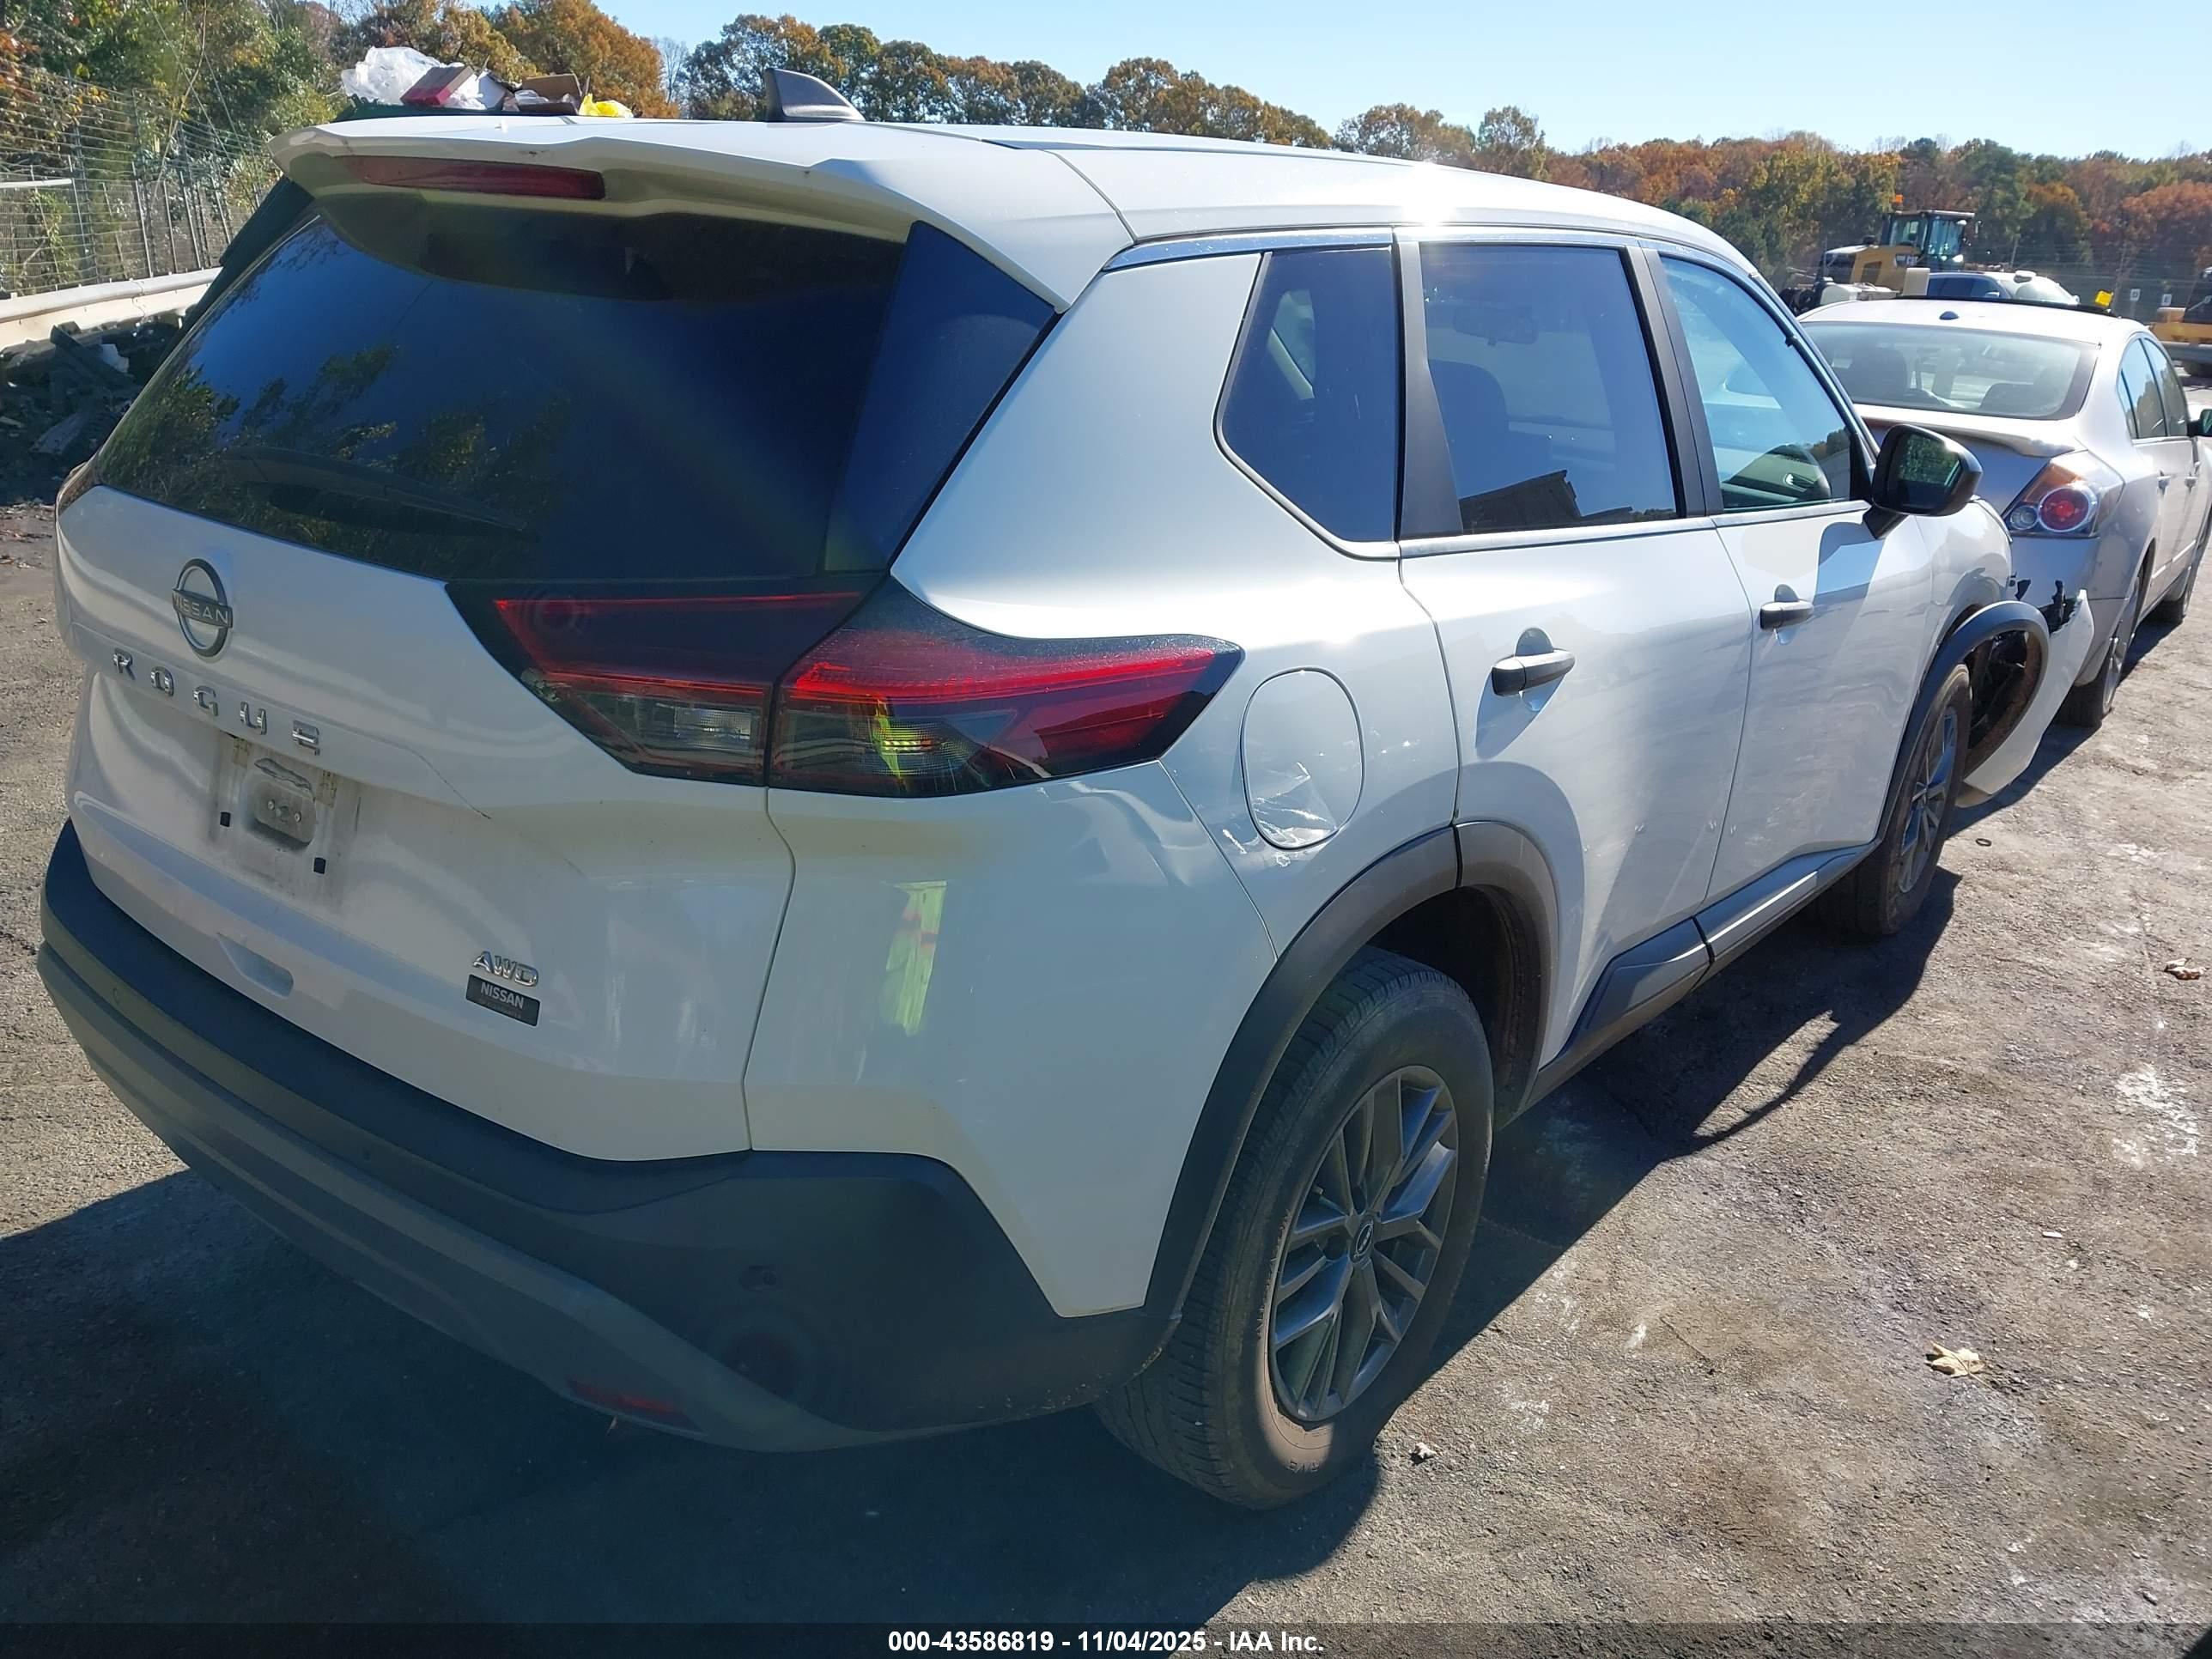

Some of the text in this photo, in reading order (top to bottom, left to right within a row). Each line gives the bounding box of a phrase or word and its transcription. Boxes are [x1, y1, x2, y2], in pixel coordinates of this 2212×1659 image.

[173, 593, 228, 624] NISSAN
[112, 647, 321, 756] ROGUE
[473, 951, 539, 987] AWD
[480, 981, 525, 1010] NISSAN
